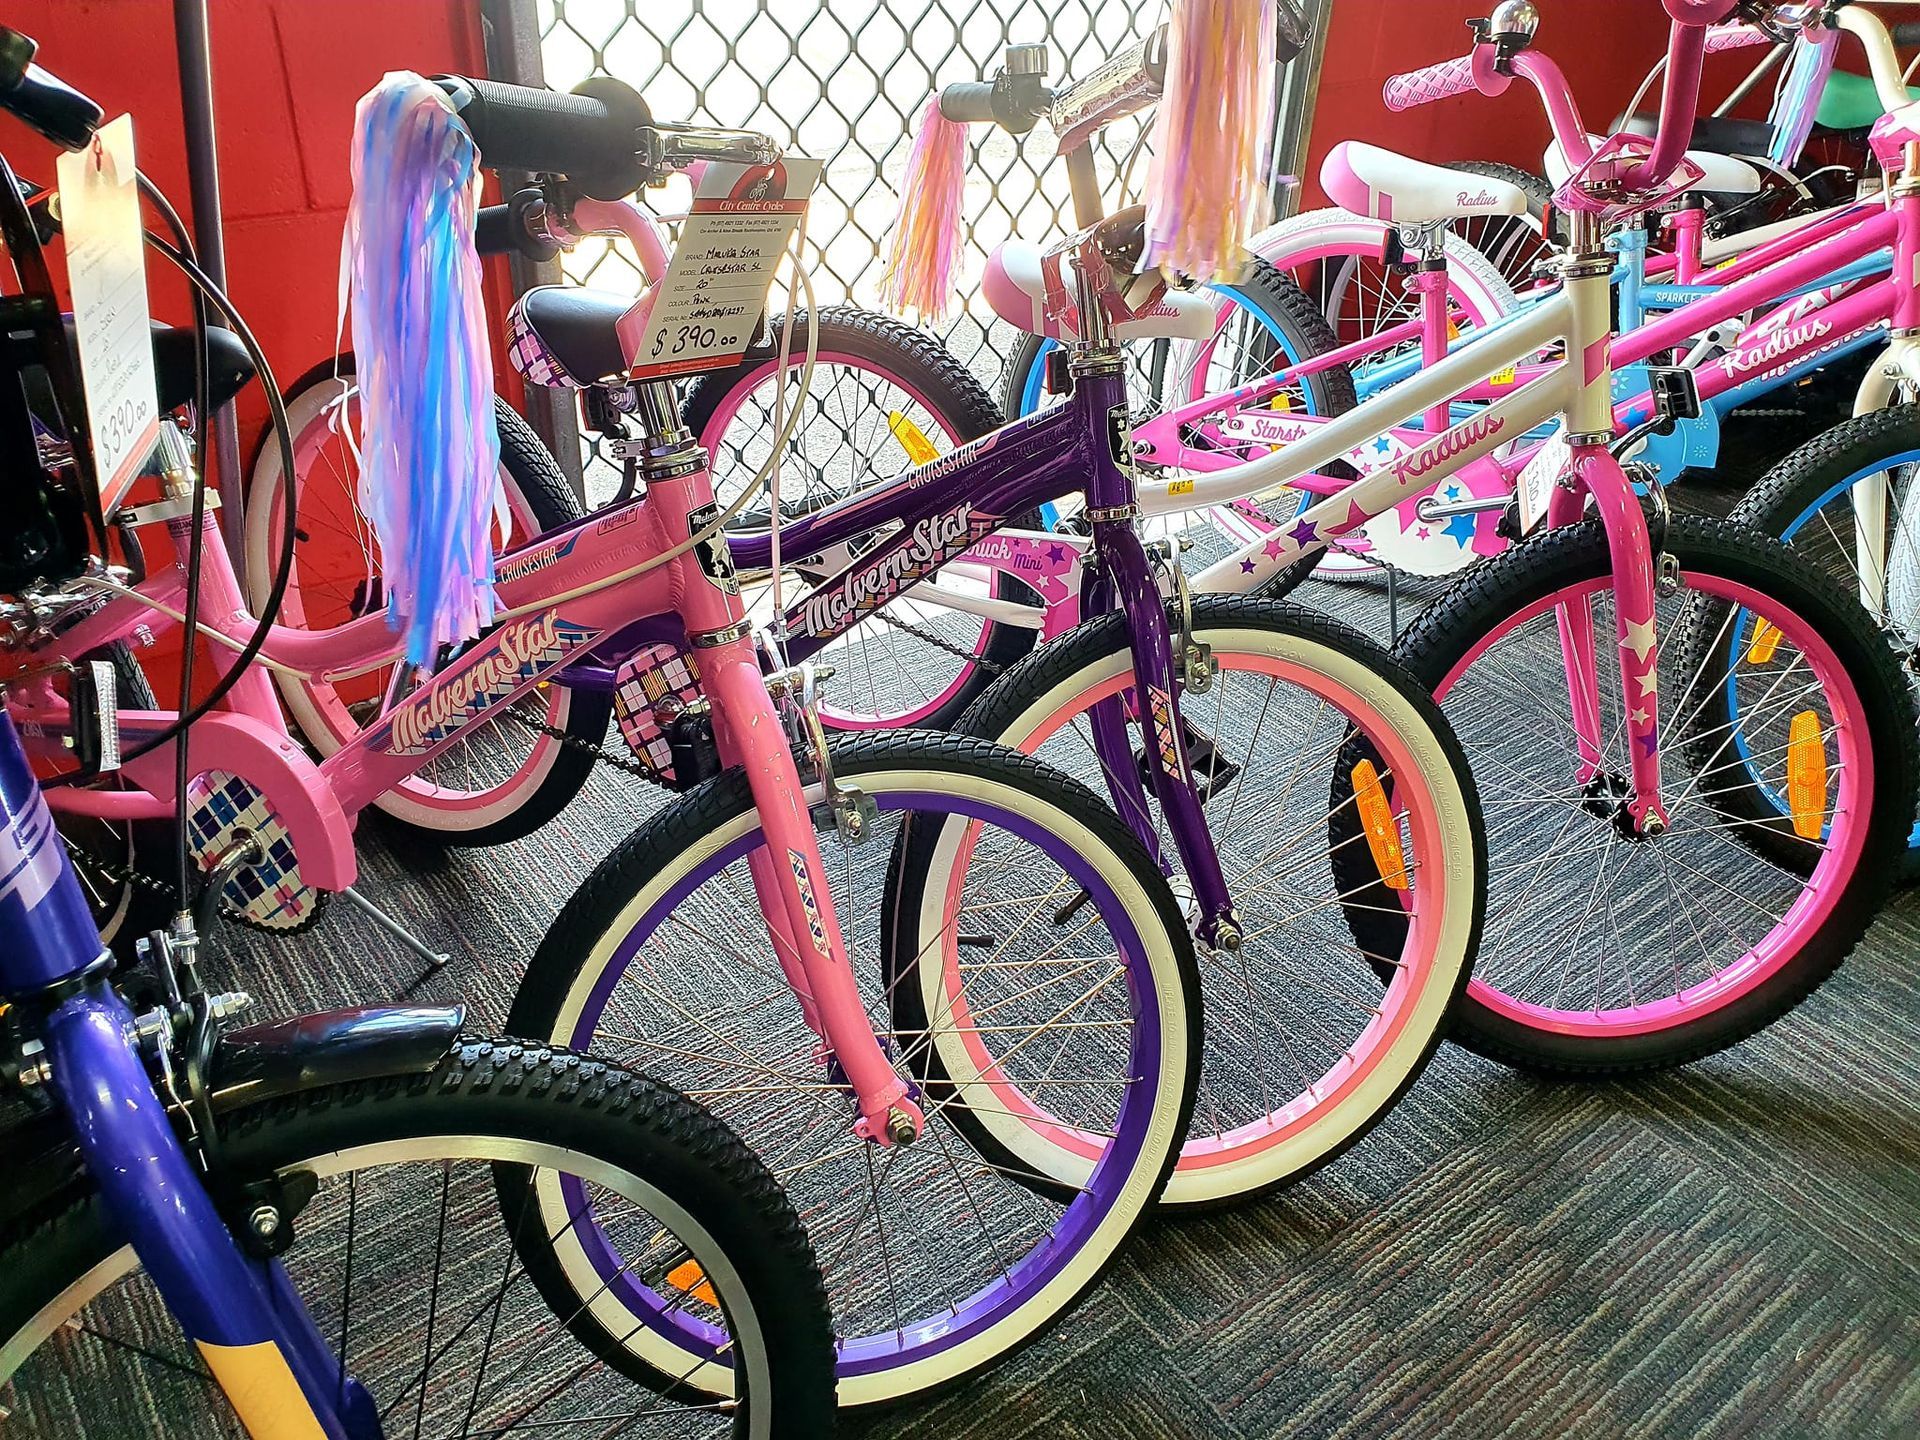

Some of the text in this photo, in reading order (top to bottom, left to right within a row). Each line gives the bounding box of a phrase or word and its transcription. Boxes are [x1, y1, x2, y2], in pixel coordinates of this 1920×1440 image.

[719, 201, 784, 213] City Centre Cycles
[1456, 189, 1499, 208] Radius
[1719, 318, 1834, 379] Radius
[907, 442, 979, 490] CRUISESTAR
[1391, 413, 1505, 486] Radius
[500, 546, 559, 585] CRUISESTAR
[797, 502, 973, 637] Malvern Star
[1013, 553, 1043, 570] Mini
[391, 608, 558, 754] Malvern Star
